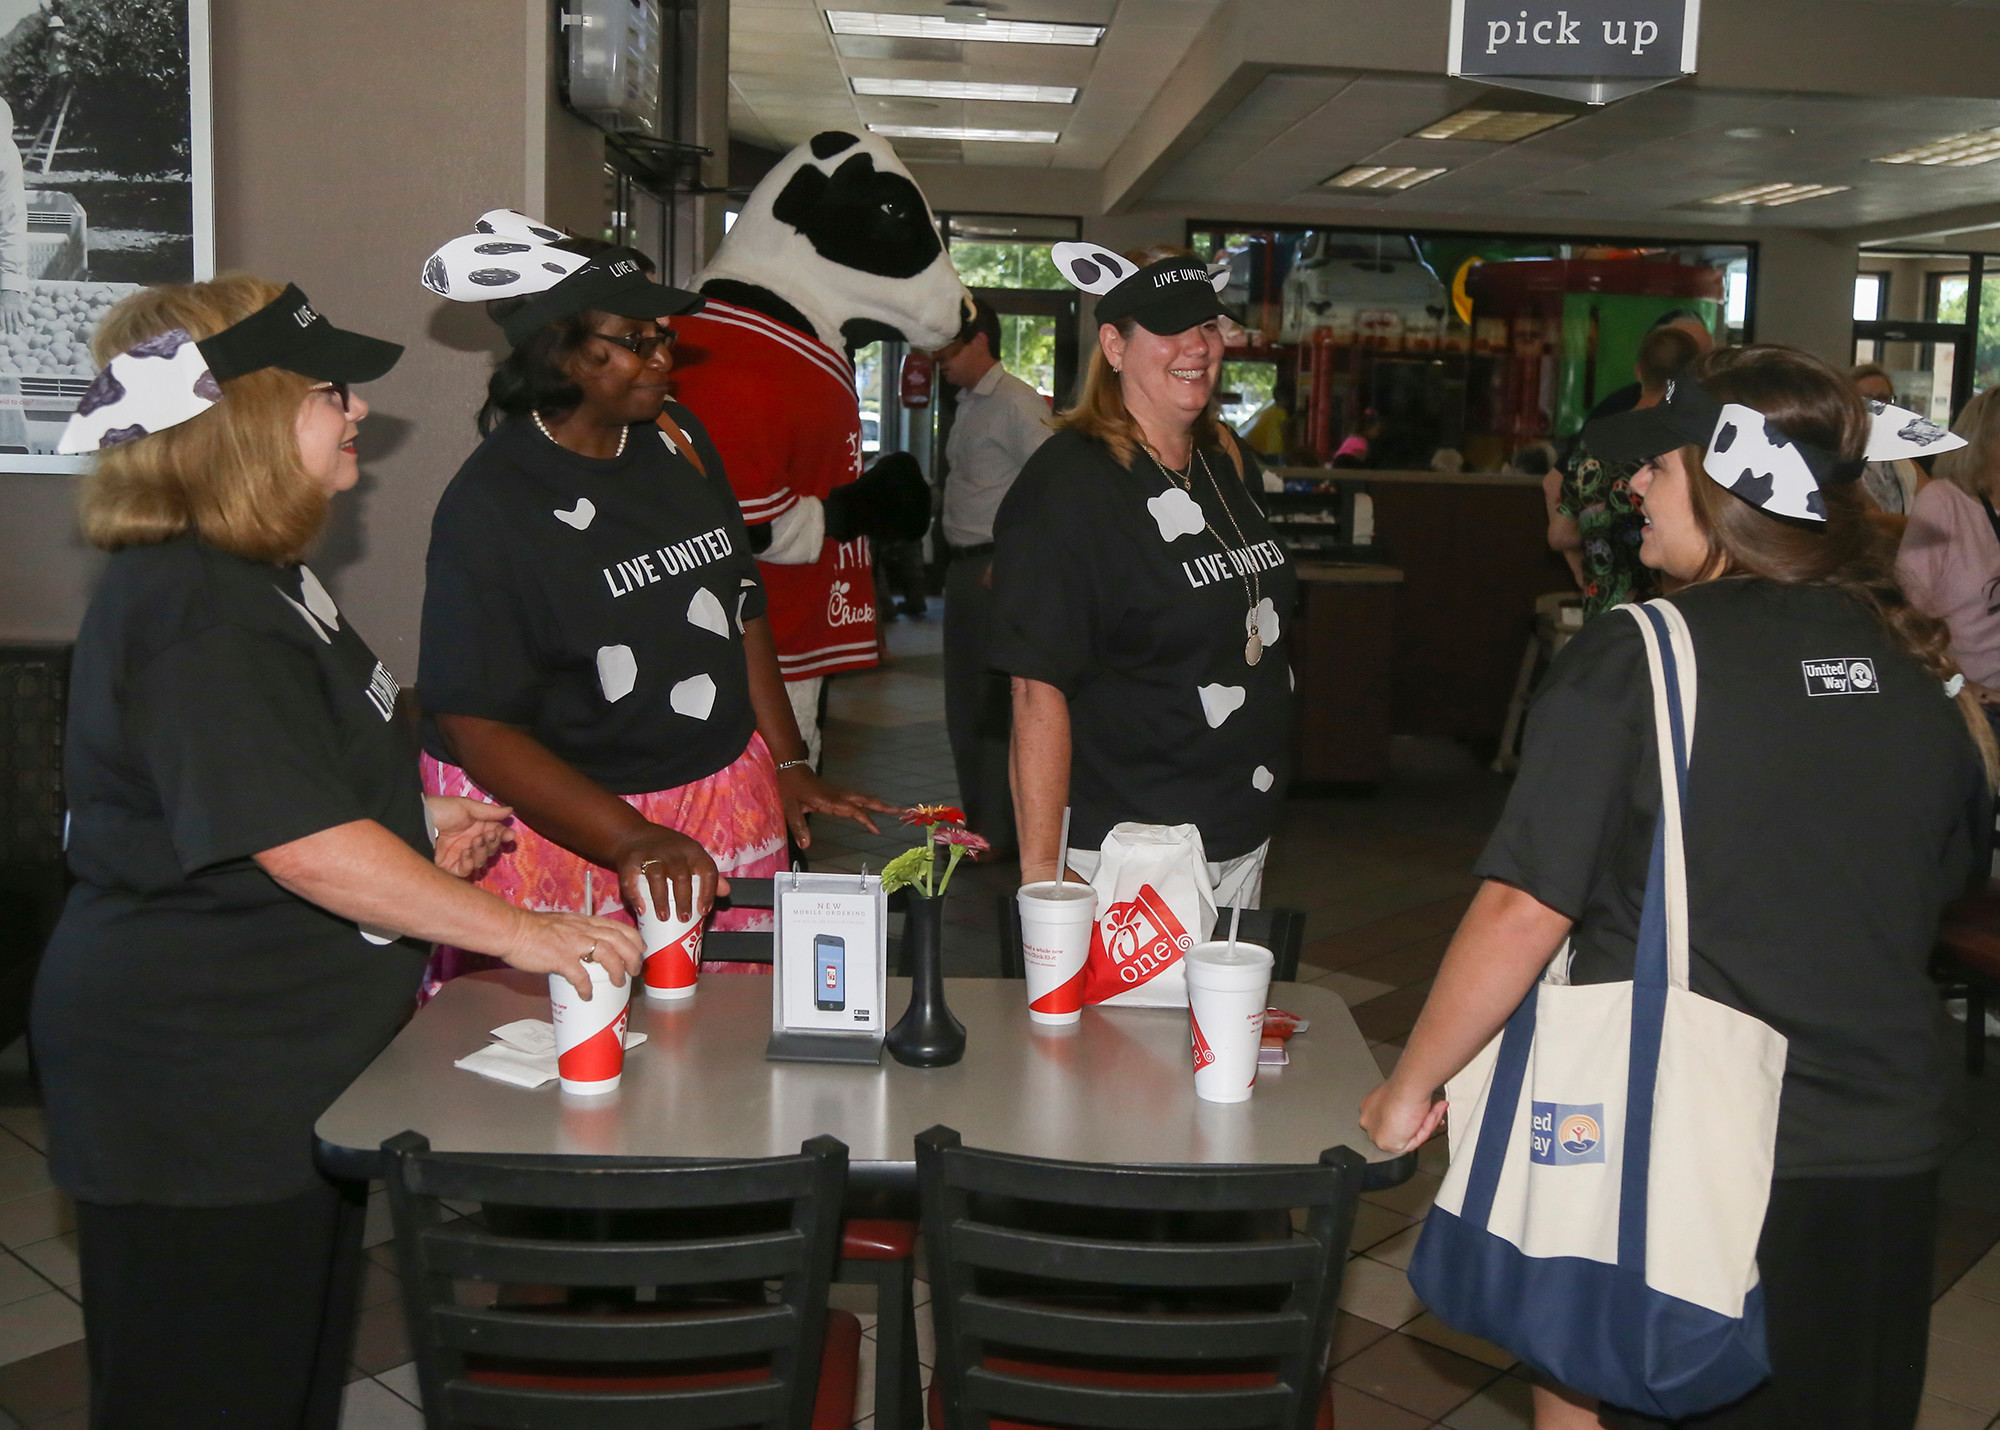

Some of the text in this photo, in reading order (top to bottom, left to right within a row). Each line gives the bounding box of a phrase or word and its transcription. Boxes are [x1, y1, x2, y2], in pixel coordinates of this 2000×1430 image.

[1486, 10, 1659, 55] pick up
[609, 261, 633, 277] LIVE
[1153, 270, 1180, 288] LIVE
[603, 527, 733, 598] LIVE UNITED
[1182, 540, 1285, 589] LIVE UNITED
[1806, 663, 1846, 677] United
[1822, 677, 1847, 691] Way
[817, 902, 841, 910] NEW
[1120, 941, 1172, 983] one
[1531, 1131, 1552, 1157] ay
